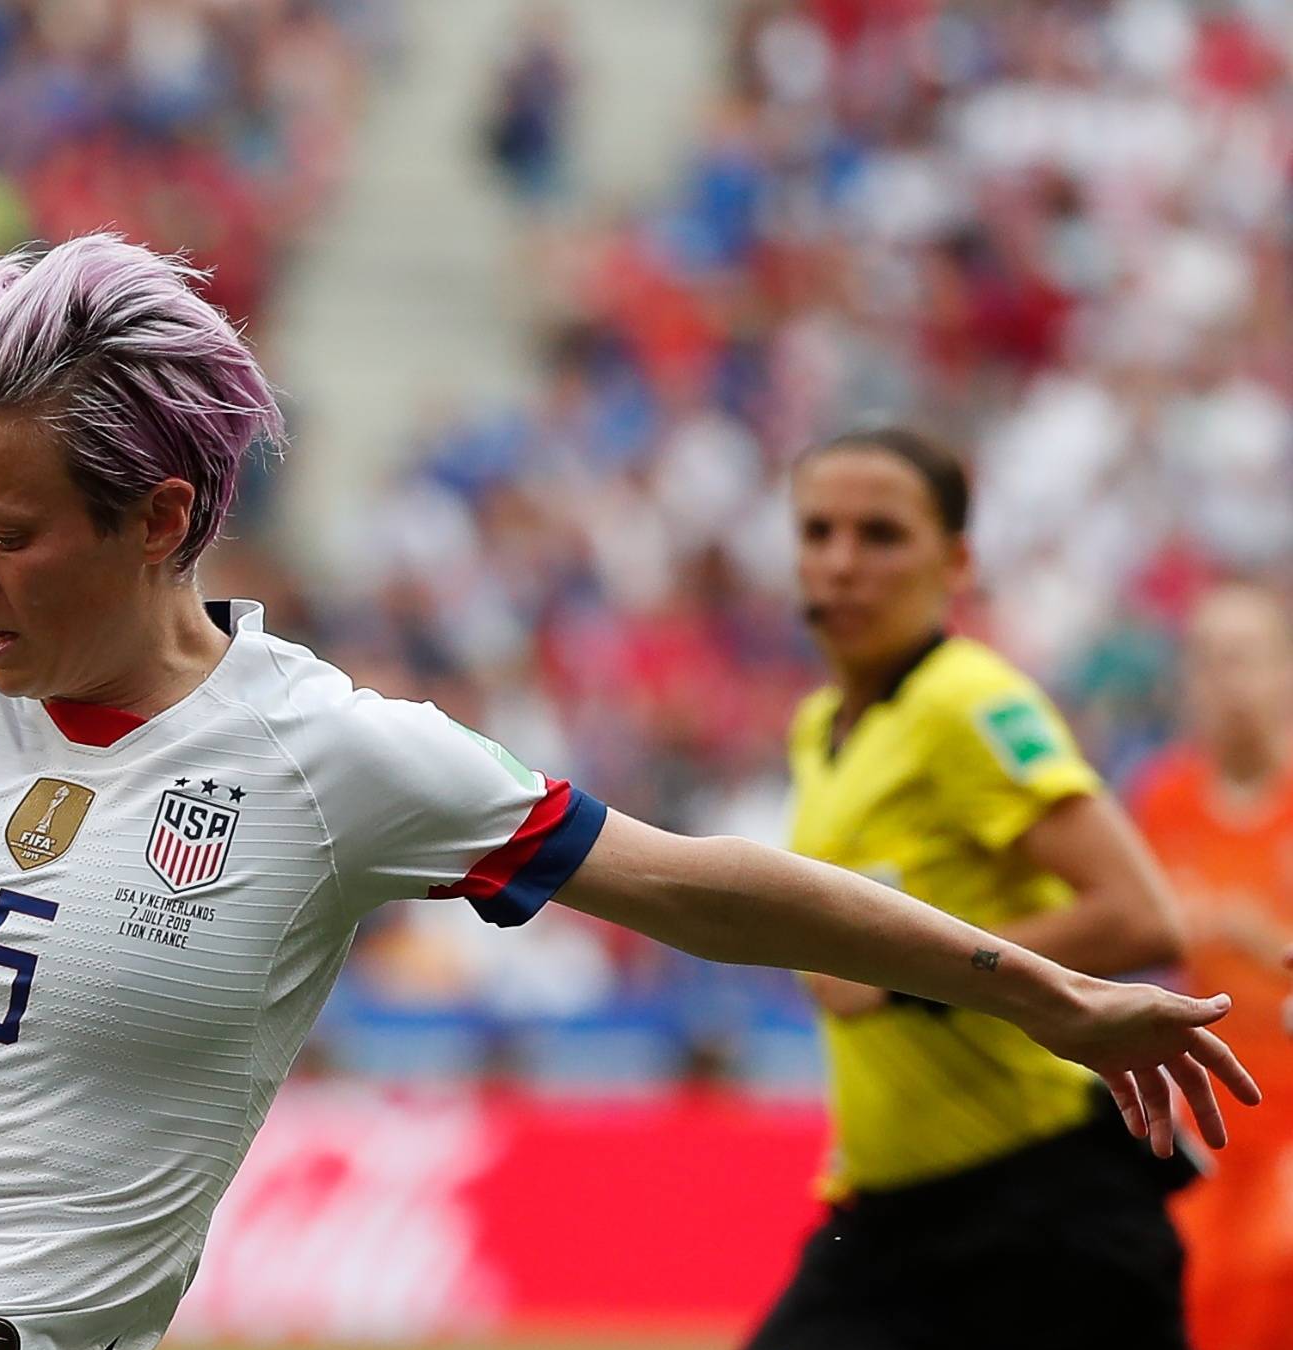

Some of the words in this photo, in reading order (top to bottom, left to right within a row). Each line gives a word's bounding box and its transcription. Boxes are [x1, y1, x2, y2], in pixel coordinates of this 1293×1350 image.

[164, 798, 230, 840] USA
[19, 831, 52, 850] FIFA
[114, 887, 136, 904] USA
[139, 891, 149, 905] V
[147, 893, 216, 922] NETHERLANDS
[129, 906, 139, 919] 7
[138, 909, 165, 926] JULY
[165, 915, 192, 932] 2019
[117, 921, 147, 939] LYON
[147, 927, 190, 950] FRANCE
